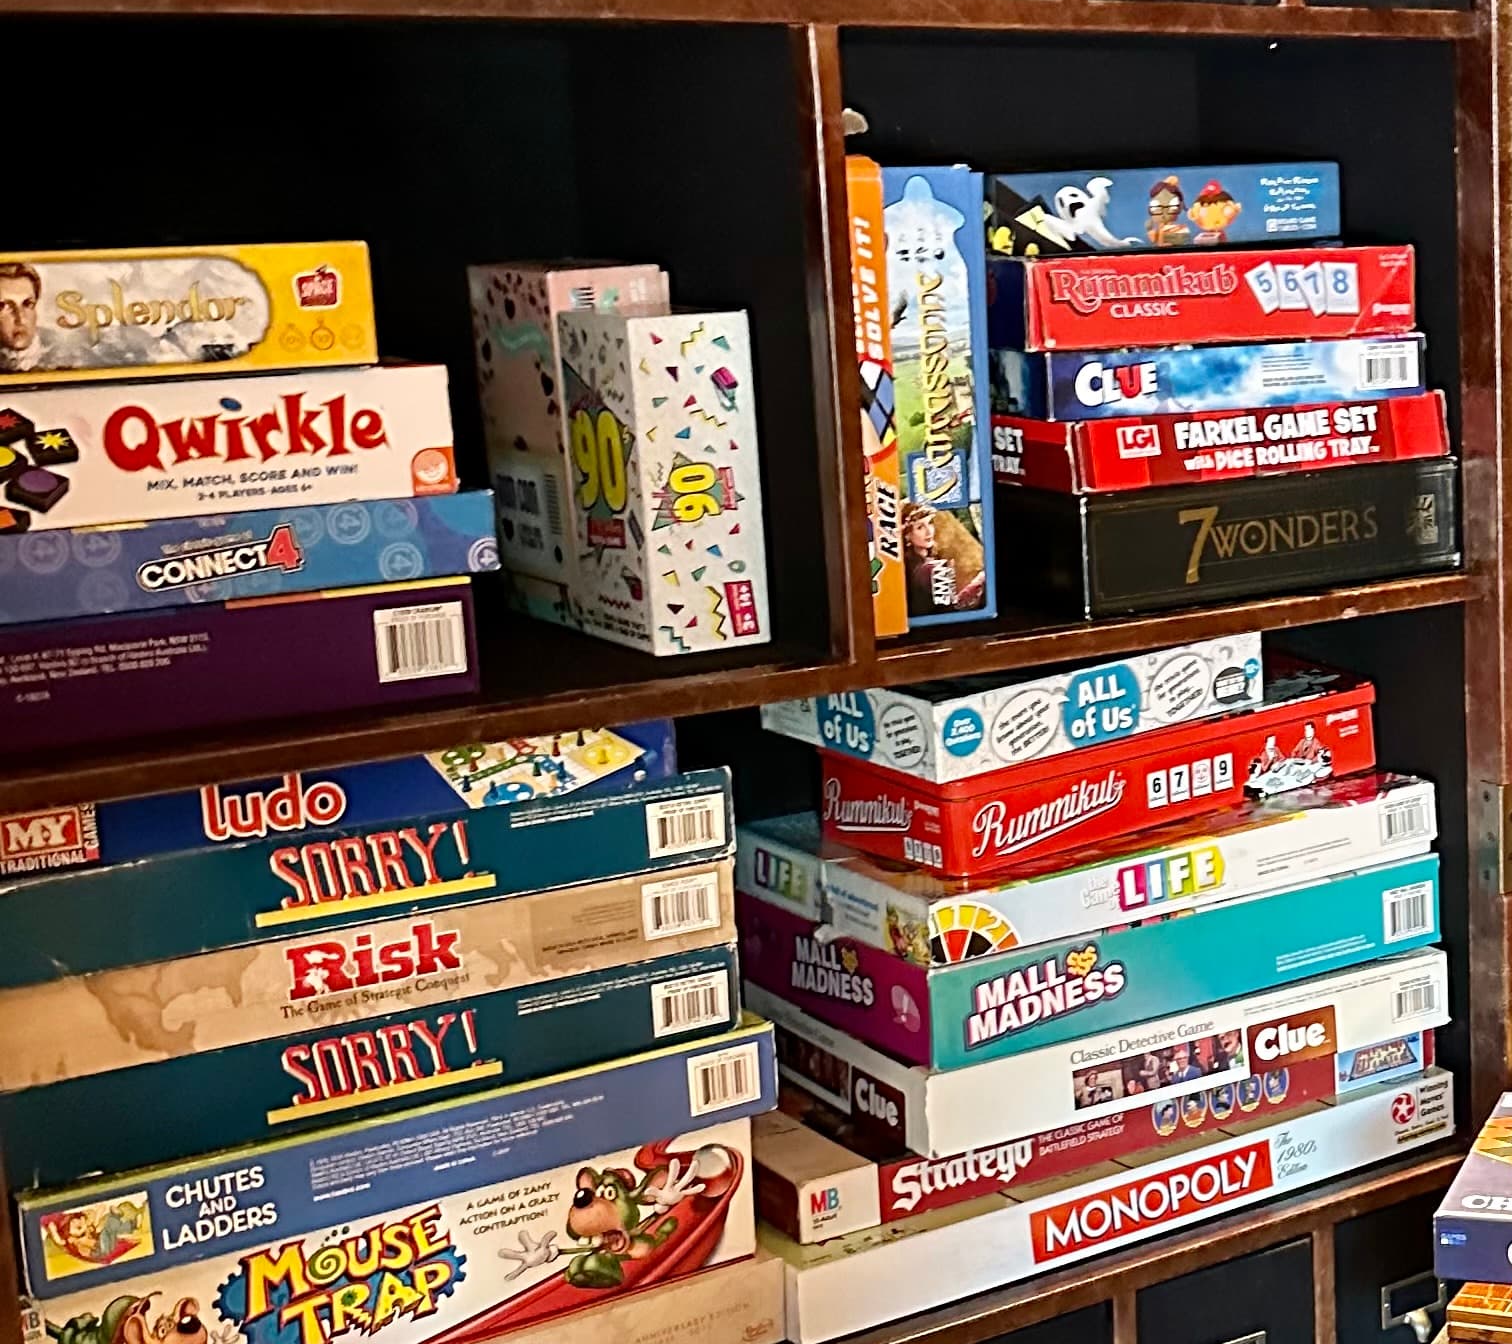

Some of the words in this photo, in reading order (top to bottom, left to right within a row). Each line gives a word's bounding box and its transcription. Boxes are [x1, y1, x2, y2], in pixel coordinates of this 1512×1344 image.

[853, 215, 874, 261] IT!
[55, 278, 250, 345] Splendor
[1050, 263, 1238, 314] Rummikub
[1110, 301, 1180, 319] CLASSIC
[862, 264, 885, 361] SOLVE
[1074, 360, 1159, 407] CLUE
[103, 392, 391, 473] Qwirkle
[1174, 414, 1265, 450] FARKEL
[1263, 410, 1335, 444] GAME
[1335, 405, 1379, 436] SET
[147, 477, 178, 493] MIX,
[182, 470, 235, 490] MATCH,
[239, 466, 288, 484] SCORE
[292, 463, 323, 479] AND
[326, 462, 360, 476] WIN!
[1214, 449, 1255, 471] DICE
[1256, 441, 1327, 468] ROLLING
[218, 487, 267, 501] PLAYERS
[876, 479, 900, 559] RACE
[142, 542, 269, 589] CONNECT
[266, 524, 301, 571] 4
[1178, 507, 1219, 584] 7
[1208, 506, 1379, 559] WONDERS
[1077, 673, 1128, 707] ALL
[823, 718, 845, 745] of
[844, 725, 871, 754] Us
[1070, 713, 1099, 737] of
[1101, 703, 1135, 731] Us
[203, 773, 346, 840] ludo
[824, 777, 913, 829] Rummikub
[972, 769, 1127, 858] Rummikub
[5, 814, 72, 853] MY
[0, 848, 86, 875] TRADITIONAL
[270, 819, 476, 912] SORRY!
[756, 849, 810, 900] LIFE
[1121, 852, 1218, 906] LIFE
[286, 922, 463, 1001] Risk
[795, 935, 842, 971] MALL
[280, 1001, 306, 1021] The
[307, 995, 344, 1017] Game
[346, 990, 360, 1009] of
[360, 981, 414, 1006] Strategic
[414, 971, 473, 996] Conquest
[791, 961, 875, 1008] MADNESS
[967, 963, 1125, 1047] MADNESS
[974, 959, 1067, 1014] MALL
[281, 1008, 483, 1105] SORRY!
[1070, 1041, 1117, 1066] Classic
[1117, 1027, 1177, 1056] Detective
[1177, 1018, 1216, 1041] Game
[1253, 1021, 1325, 1062] Clue
[853, 1075, 901, 1128] Clue
[1418, 1079, 1450, 1095] Winning
[1038, 1130, 1057, 1145] THE
[1056, 1123, 1087, 1140] CLASSIC
[1086, 1117, 1112, 1133] GAME
[1418, 1104, 1446, 1119] Games
[1038, 1135, 1088, 1157] BATTLEFIELD
[1086, 1124, 1126, 1146] STRATEGY
[1274, 1131, 1294, 1148] The
[1277, 1139, 1319, 1164] 1980s
[164, 1165, 265, 1209] CHUTES
[466, 1199, 478, 1212] A
[477, 1192, 507, 1208] GAME
[507, 1188, 521, 1202] OF
[521, 1179, 553, 1198] ZANY
[892, 1137, 1037, 1212] Stratego
[198, 1193, 238, 1219] AND
[459, 1208, 497, 1227] ACTION
[497, 1205, 514, 1220] ON
[517, 1202, 528, 1215] A
[528, 1191, 562, 1211] CRAZY
[472, 1209, 550, 1237] CONTRAPTION!
[810, 1186, 841, 1216] MB
[1044, 1150, 1259, 1254] MONOPOLY
[161, 1202, 279, 1251] LADDERS
[241, 1203, 454, 1323] MOUSE
